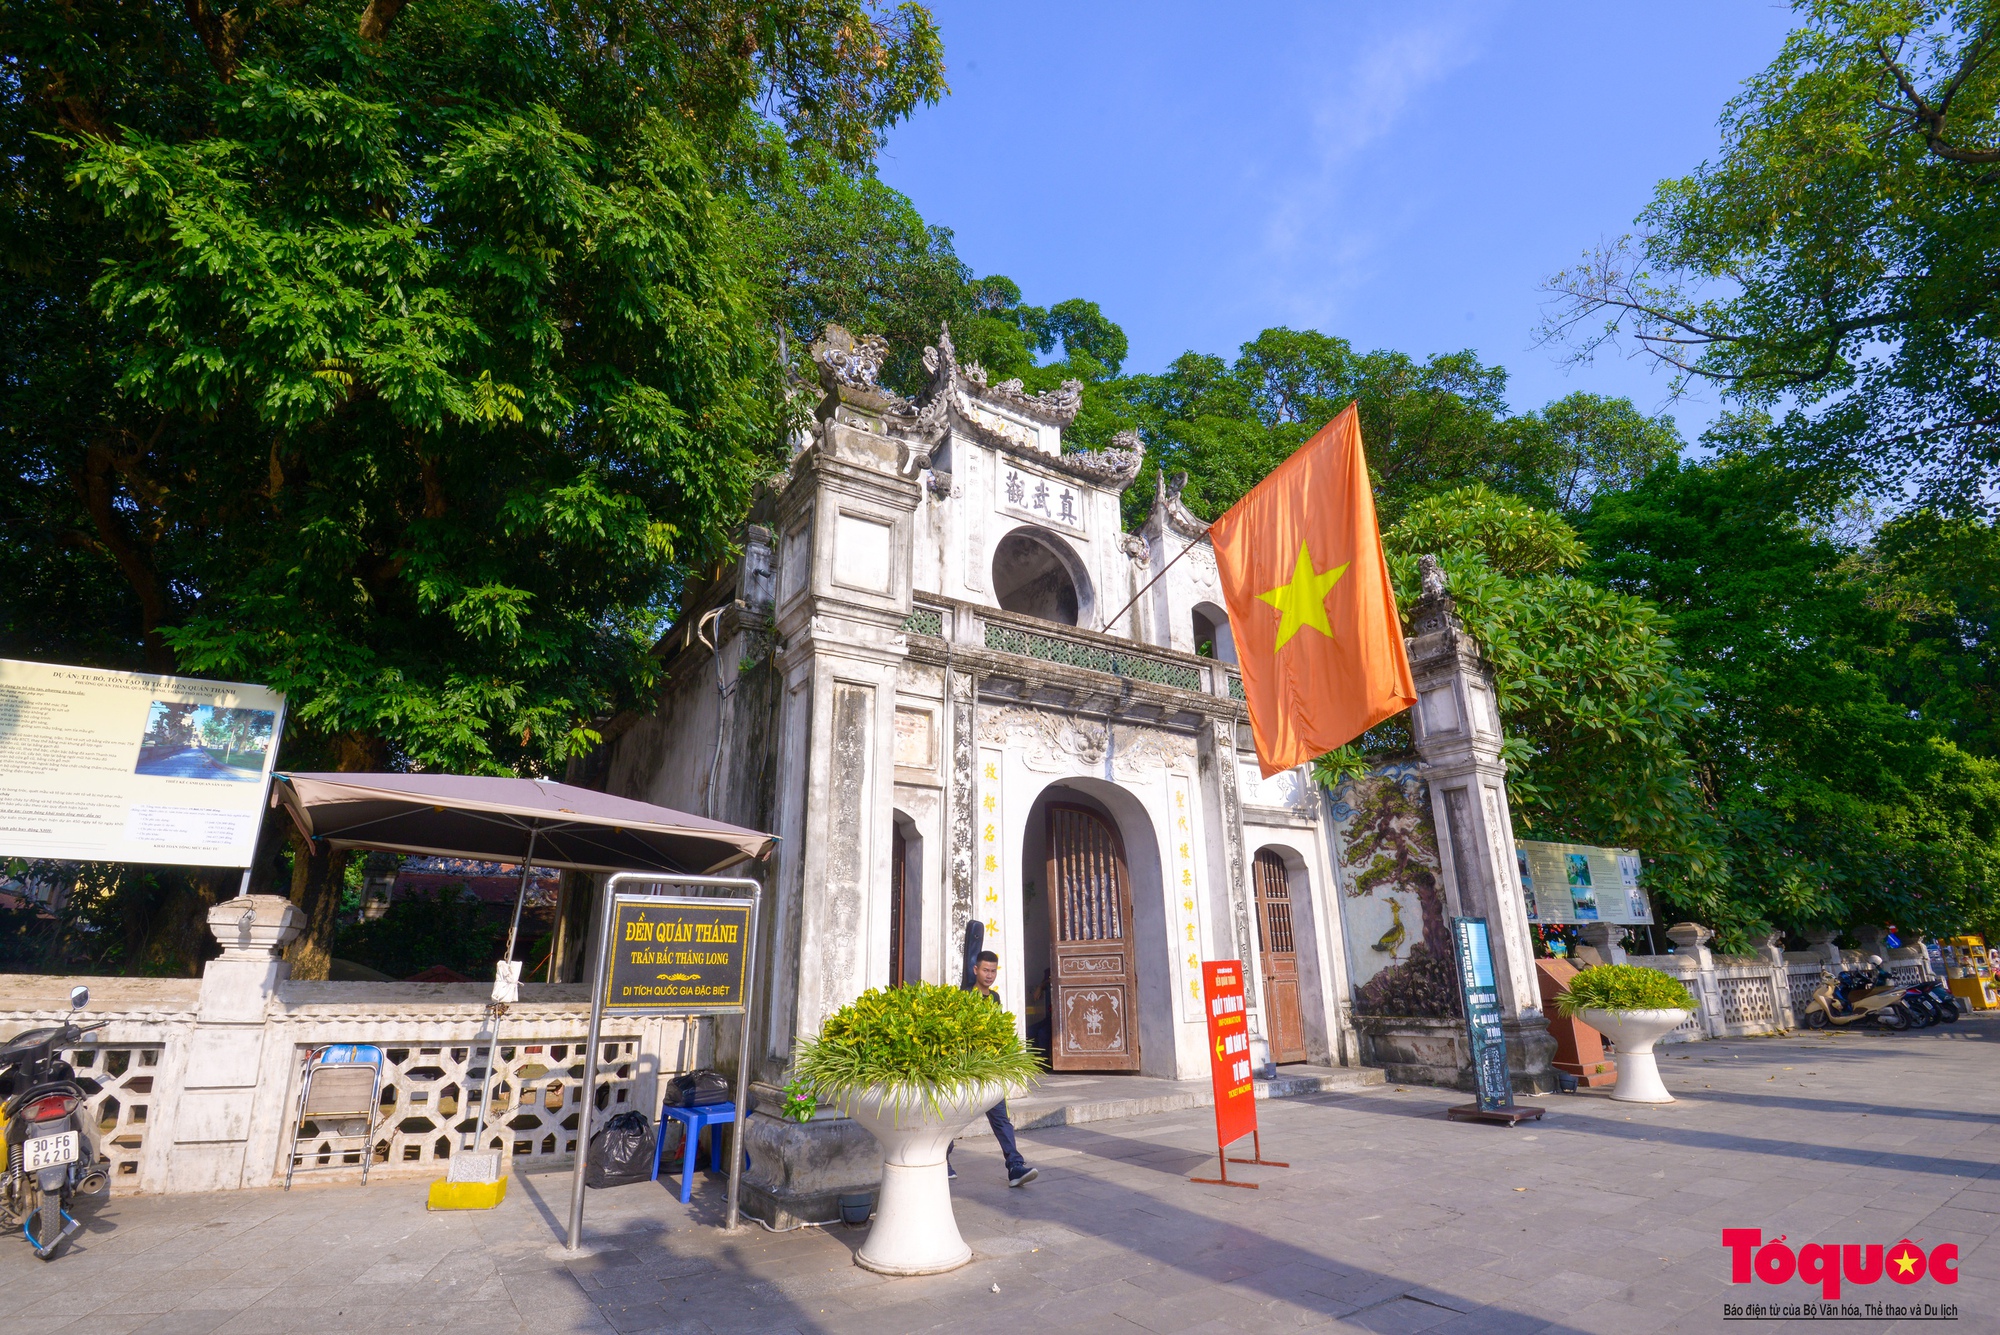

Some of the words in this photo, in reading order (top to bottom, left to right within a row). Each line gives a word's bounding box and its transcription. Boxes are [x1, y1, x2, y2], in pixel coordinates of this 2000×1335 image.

[625, 912, 655, 941] ĐỀN
[655, 917, 694, 943] QUÁN
[695, 918, 738, 943] THÁNH
[630, 946, 656, 964] TRẤN
[656, 946, 674, 964] BẮC
[675, 949, 705, 964] THĂNG
[706, 952, 729, 964] LONG
[622, 986, 632, 996] DI
[634, 984, 653, 996] TÍCH
[654, 984, 678, 996] QUỐC
[680, 986, 693, 996] GIA
[694, 985, 712, 997] ĐẶC
[712, 985, 730, 997] BIỆT
[33, 1148, 70, 1166] 6420
